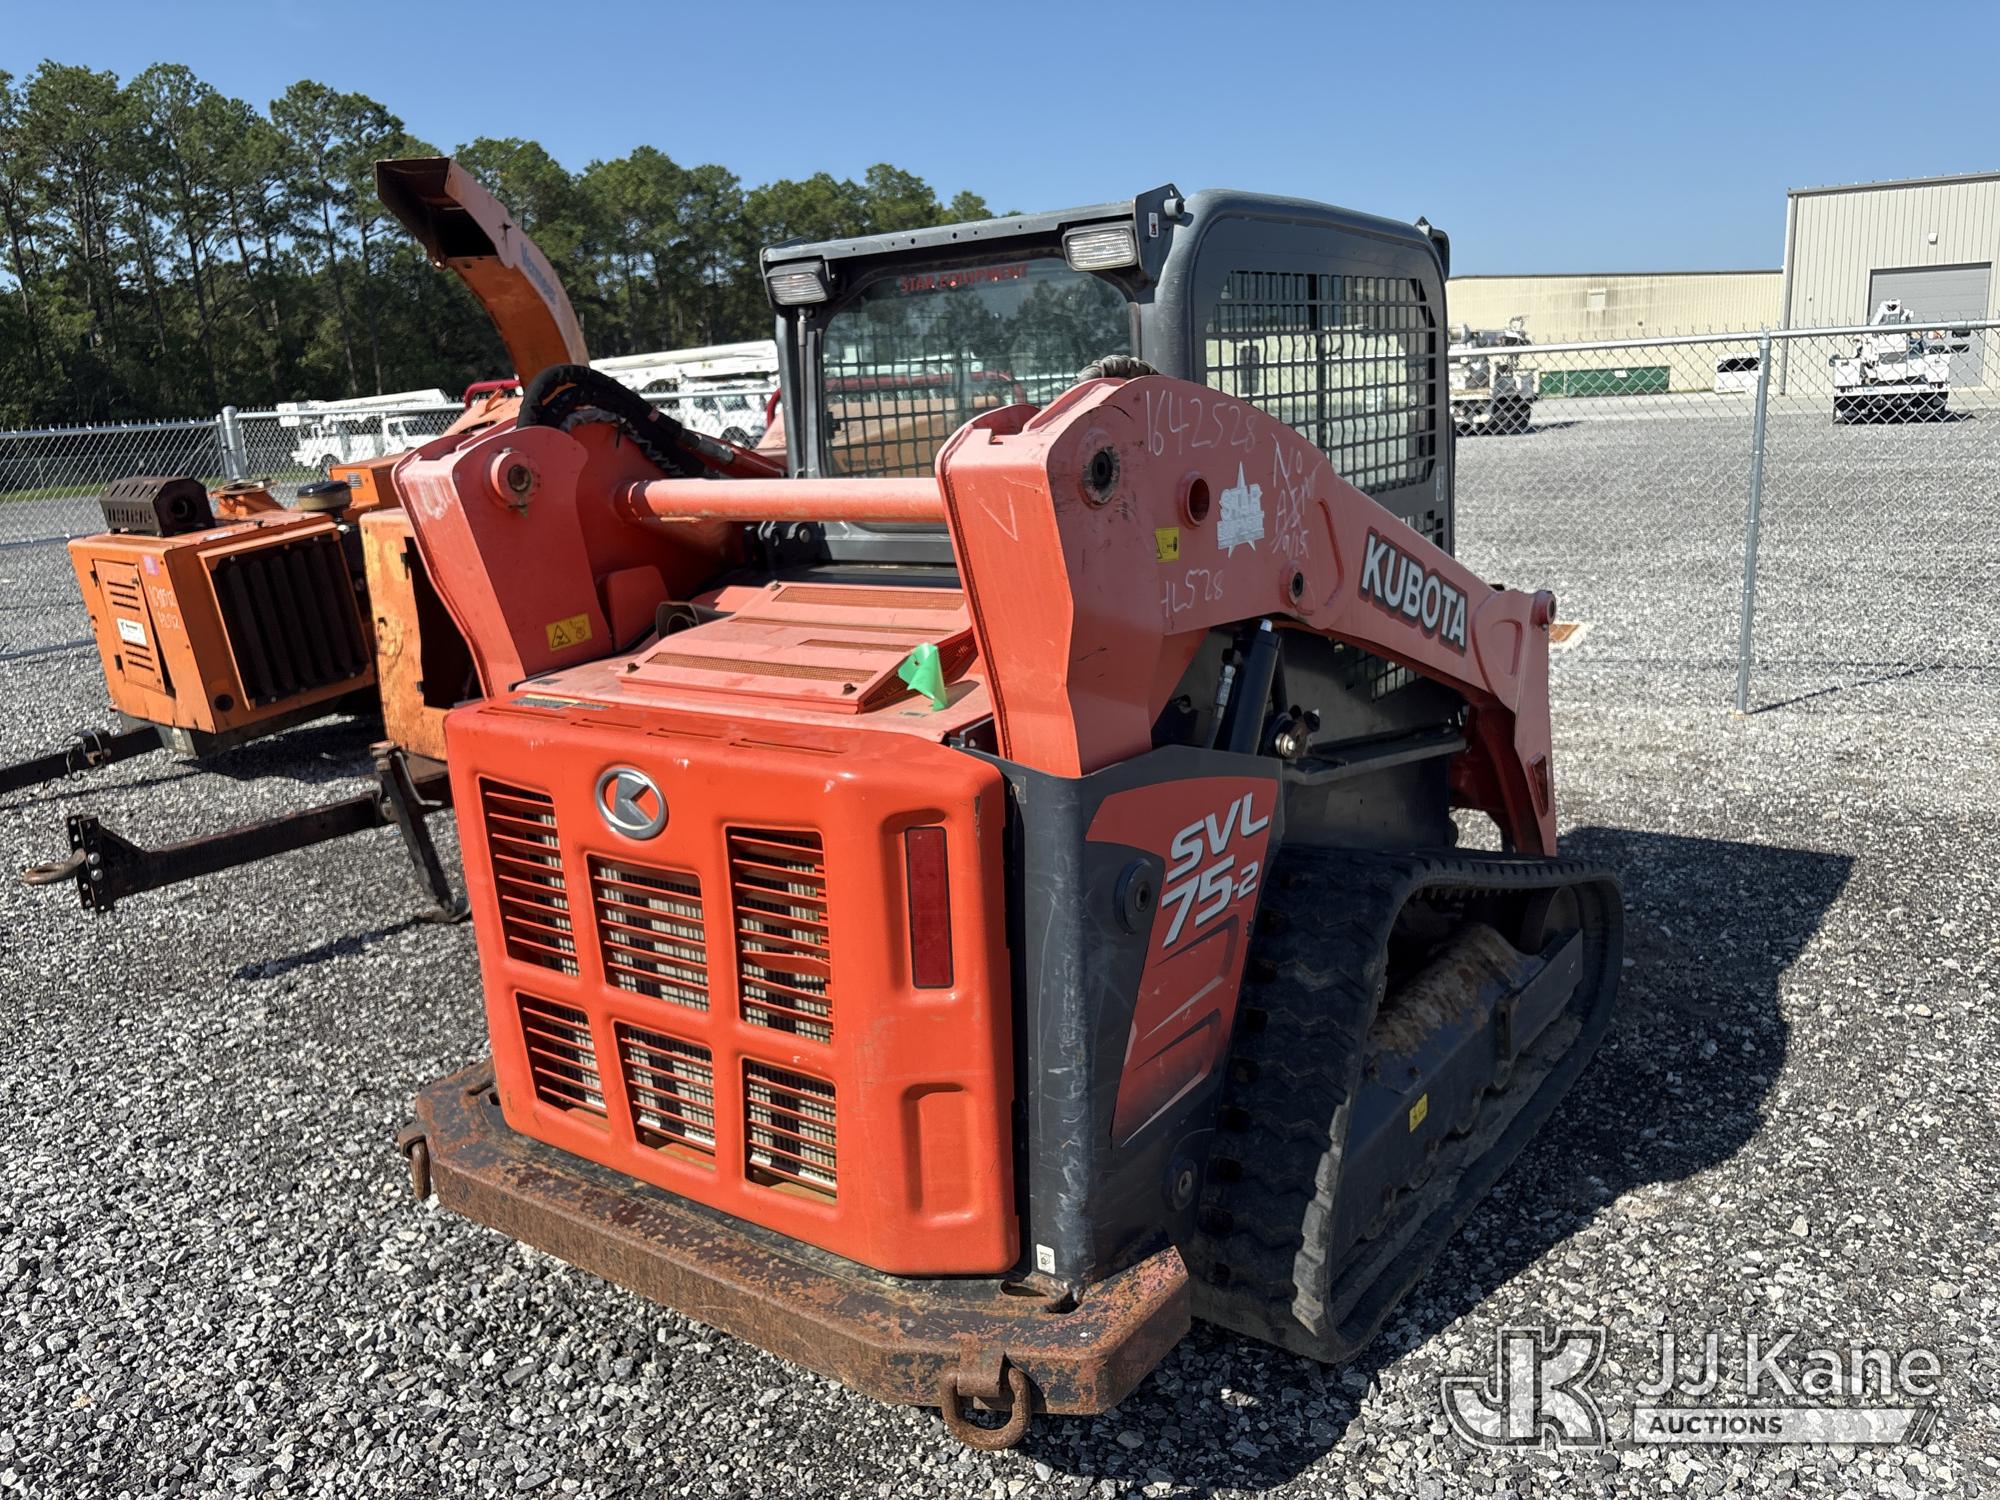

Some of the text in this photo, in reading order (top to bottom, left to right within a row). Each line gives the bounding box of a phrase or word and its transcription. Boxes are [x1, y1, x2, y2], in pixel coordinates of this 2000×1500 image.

[1361, 533, 1467, 648] KUBOTA
[1166, 791, 1270, 884] SVL
[1161, 854, 1260, 949] 75-2
